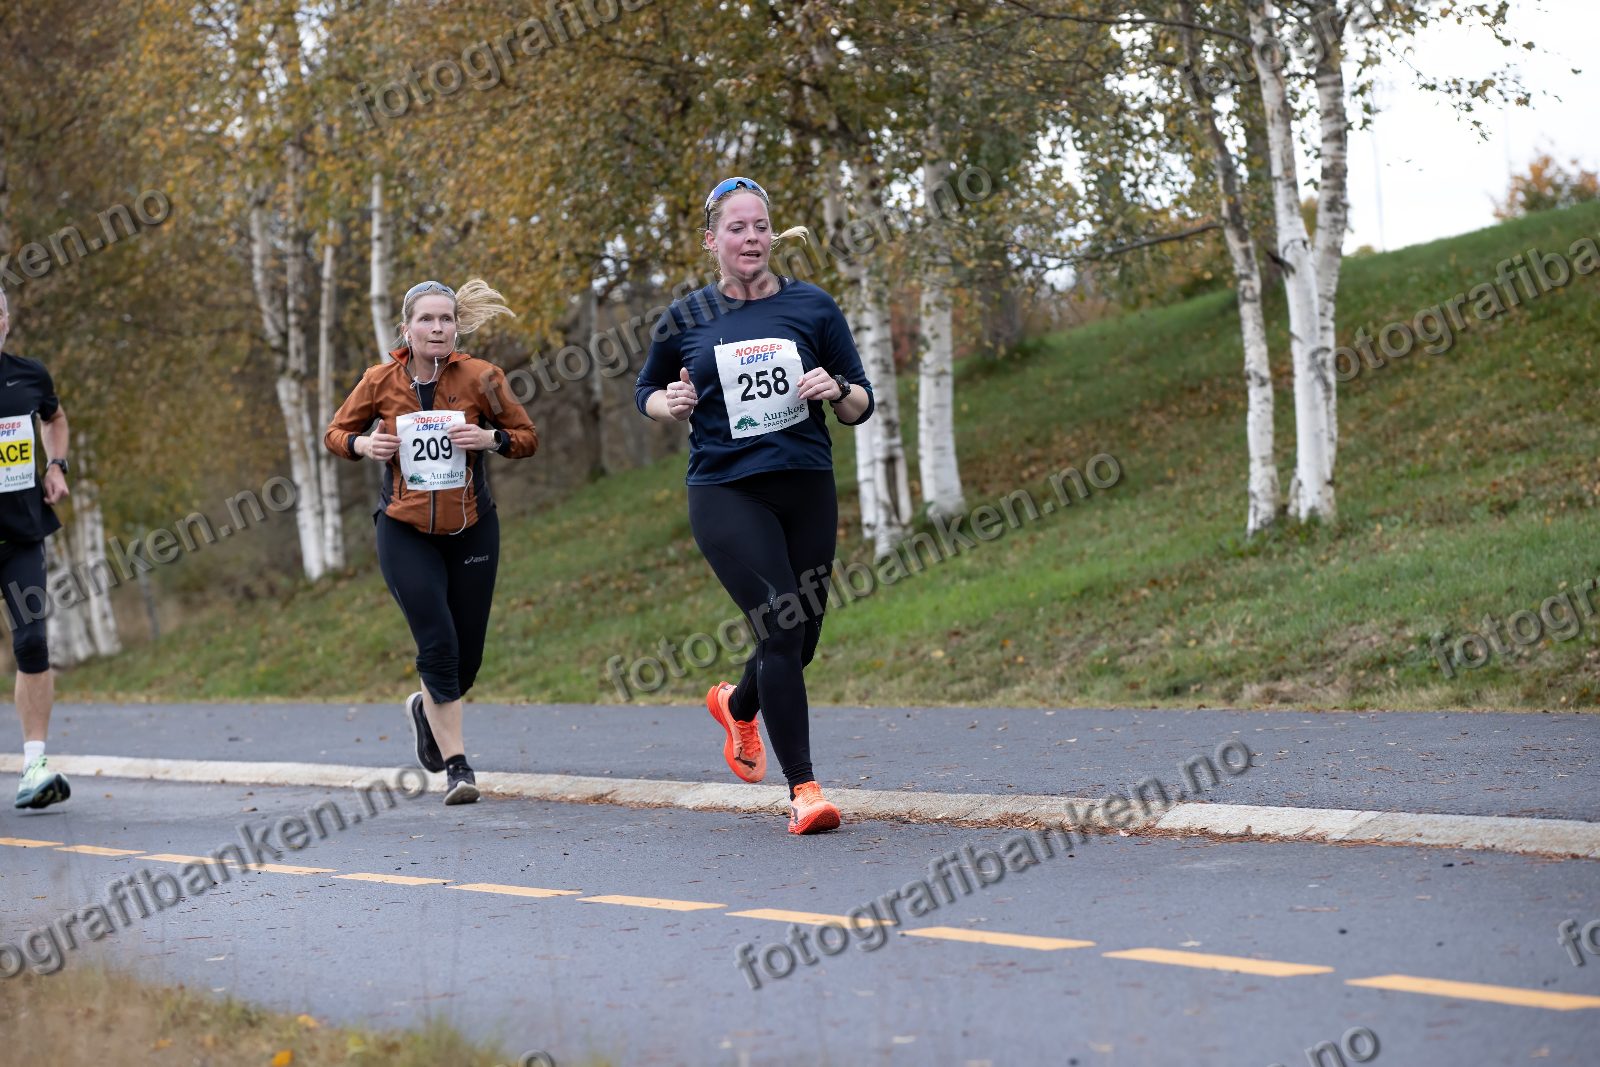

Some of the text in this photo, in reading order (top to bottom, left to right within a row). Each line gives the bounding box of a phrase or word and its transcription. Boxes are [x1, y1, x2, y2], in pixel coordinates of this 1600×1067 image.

[734, 344, 783, 357] NORGES
[740, 351, 777, 366] LØPET
[737, 366, 789, 402] 258
[413, 415, 452, 424] NORGES
[763, 403, 806, 422] Aurskog
[416, 423, 446, 432] LØPET
[412, 435, 453, 462] 209
[429, 470, 464, 480] Aurskog
